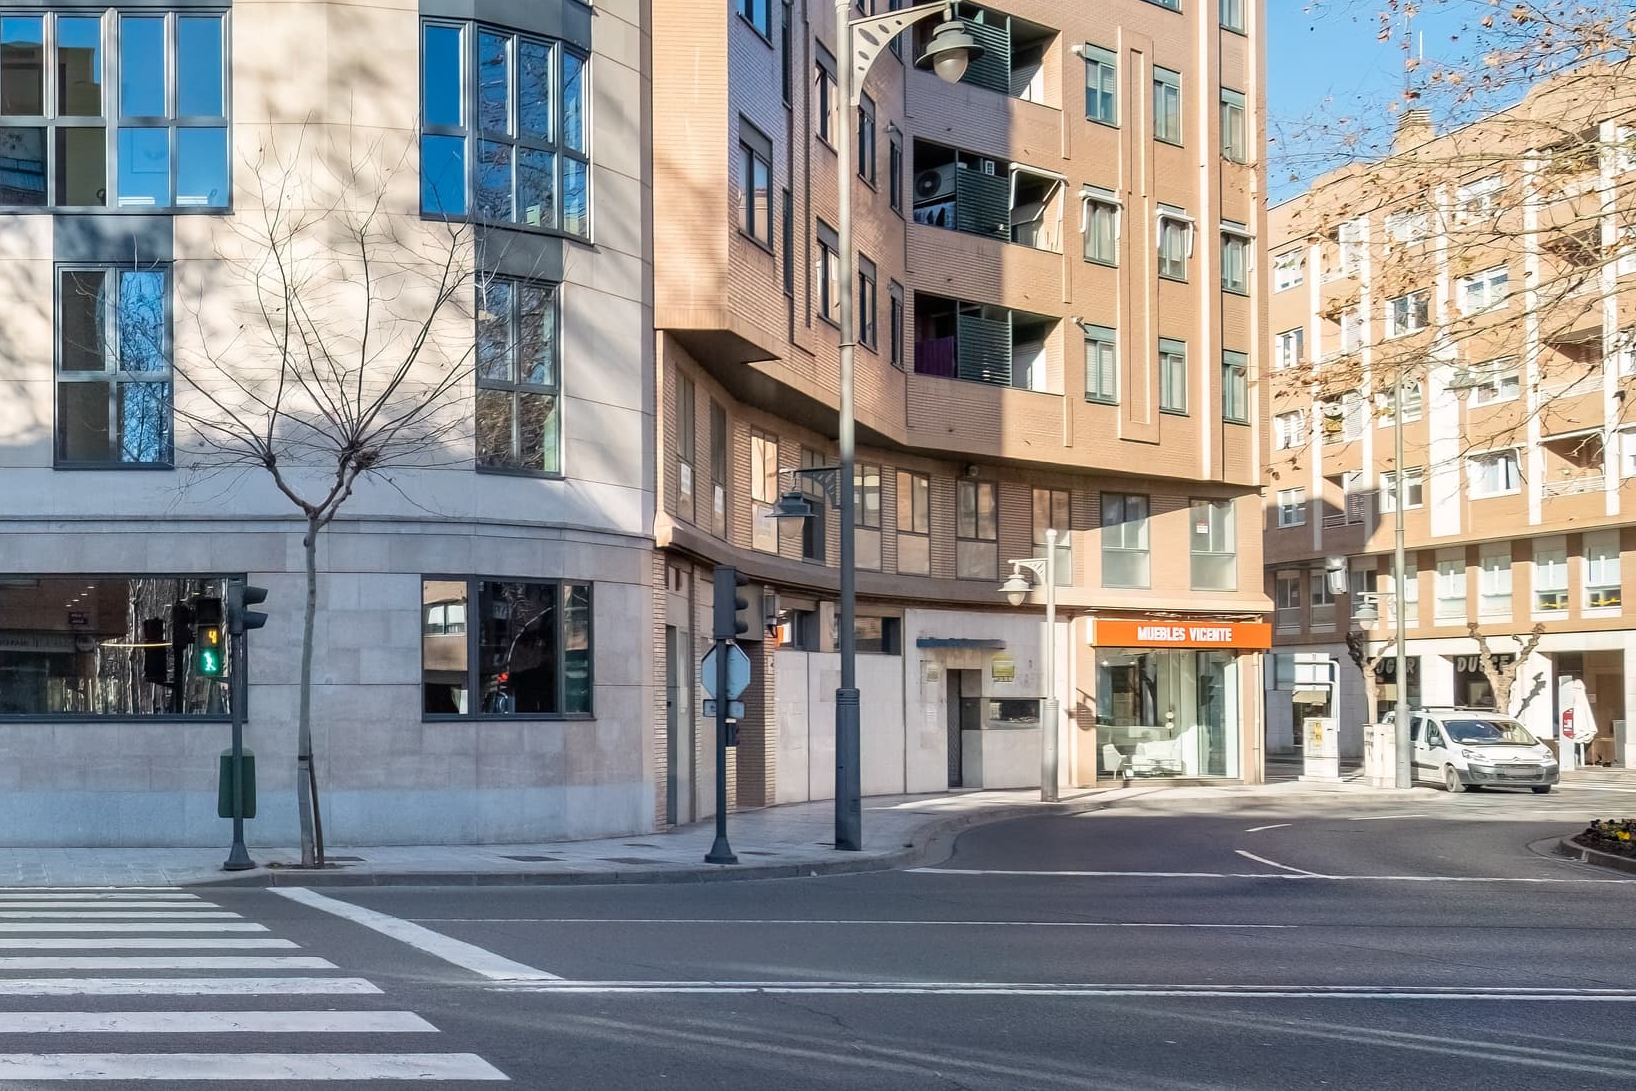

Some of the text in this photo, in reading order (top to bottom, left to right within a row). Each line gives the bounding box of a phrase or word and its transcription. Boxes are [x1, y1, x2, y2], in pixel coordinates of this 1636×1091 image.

[208, 630, 218, 645] 4
[1137, 626, 1233, 643] MUEBLES VICENTE
